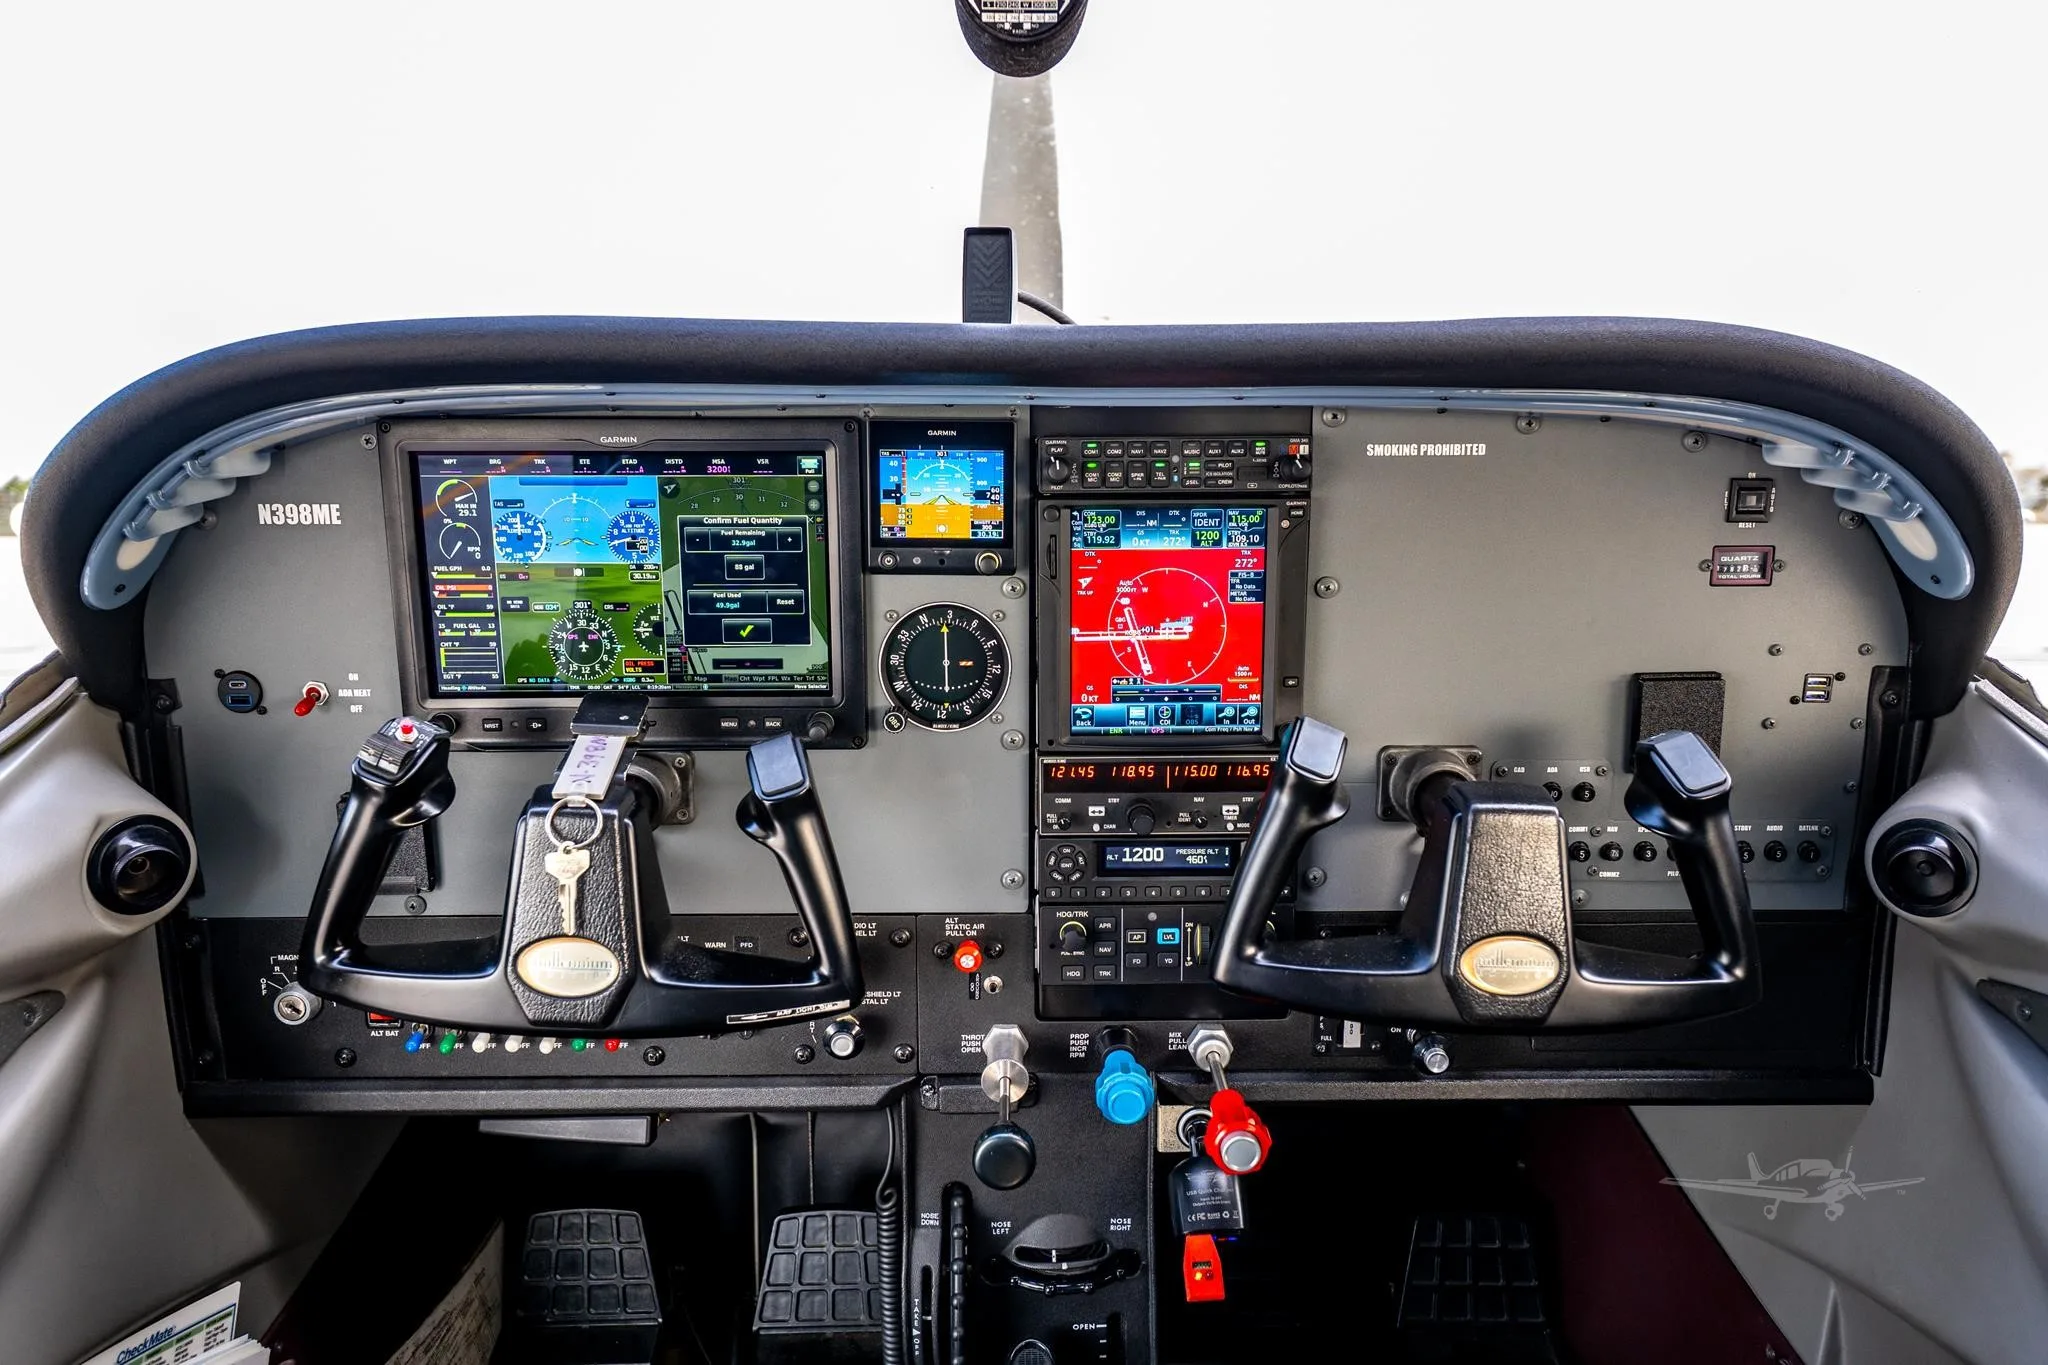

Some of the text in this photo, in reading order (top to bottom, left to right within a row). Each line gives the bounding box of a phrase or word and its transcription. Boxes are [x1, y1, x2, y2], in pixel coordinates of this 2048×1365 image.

[1366, 443, 1486, 456] SMOKING PROHIBITED
[257, 503, 342, 526] N398ME
[703, 516, 783, 525] Confirm Fuel Quantity
[1087, 516, 1115, 524] 123.00
[1194, 519, 1220, 527] IDENT
[1231, 515, 1260, 523] 115.00
[1195, 531, 1219, 540] 1200
[1231, 535, 1260, 543] 109.10
[1087, 536, 1115, 544] 119.92
[1163, 537, 1186, 546] 272°
[1235, 558, 1257, 567] 272°
[897, 629, 910, 642] 33
[348, 673, 359, 681] ON
[694, 676, 708, 684] Map
[752, 675, 765, 683] Wpt
[353, 689, 371, 697] HEAT
[350, 705, 363, 713] OFF
[888, 716, 901, 729] OBS
[1112, 765, 1155, 777] 118.95
[1174, 765, 1218, 777] 115.00
[1122, 847, 1164, 862] 1200
[1052, 873, 1063, 881] OFF
[1071, 873, 1081, 881] VFR
[1072, 1323, 1096, 1331] OPEN
[115, 1326, 175, 1364] CheckMate
